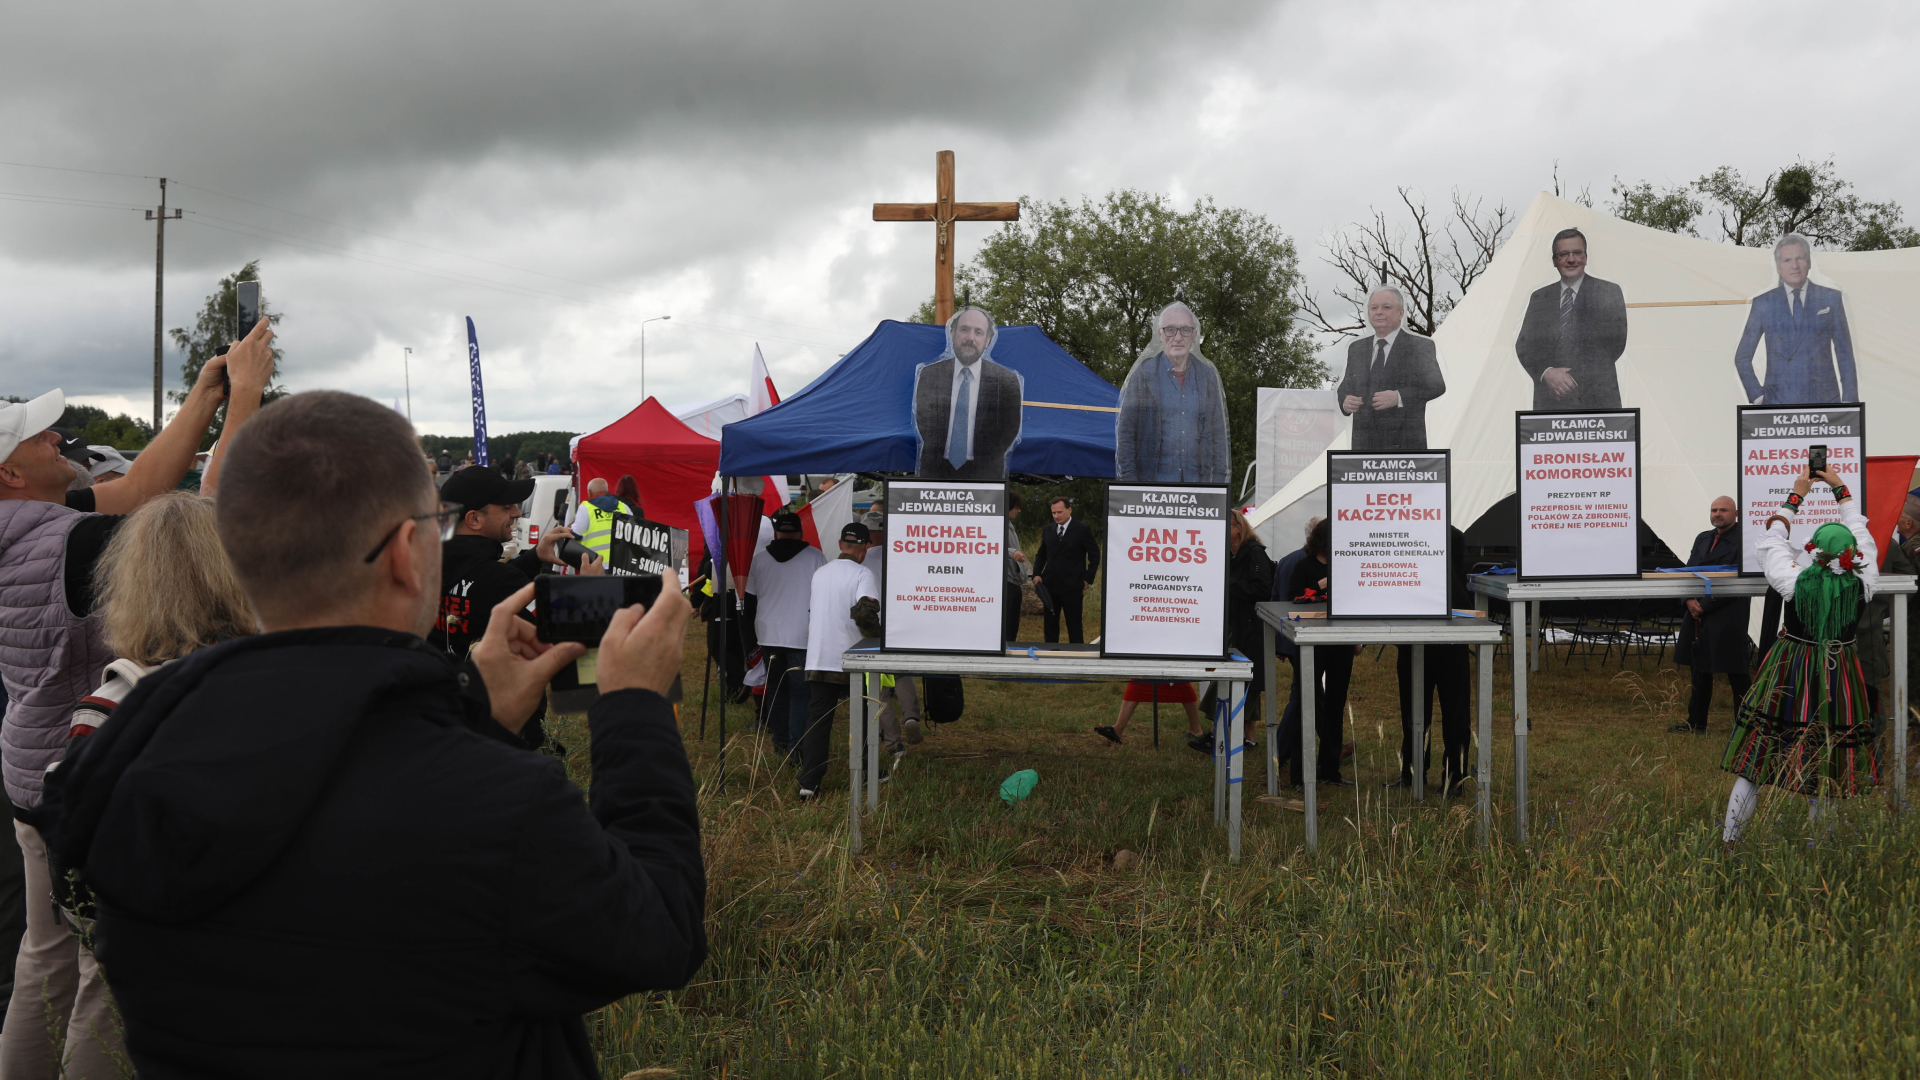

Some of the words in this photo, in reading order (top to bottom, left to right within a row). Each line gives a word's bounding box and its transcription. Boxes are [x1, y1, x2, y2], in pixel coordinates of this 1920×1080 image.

[1552, 419, 1606, 430] KŁAMCA
[1773, 414, 1829, 425] KŁAMCA
[1530, 429, 1628, 442] JEDWABIEŃSKI
[1751, 424, 1851, 437] JEDWABIEŃSKI
[1533, 452, 1625, 465] BRONISŁAW
[1748, 447, 1855, 460] ALEKSADER
[1362, 460, 1416, 469] KŁAMCA
[1744, 462, 1859, 476] KWAŚNSKI
[1341, 470, 1438, 481] JEDWABIEŃSKI
[1525, 467, 1633, 480] KOMOROWSKI
[920, 490, 975, 501] KŁAMCA
[1142, 493, 1198, 505] KŁAMCA
[1366, 494, 1412, 506] LECH
[898, 502, 996, 514] JEDWABIEŃSKI
[1119, 505, 1219, 517] JEDWABIEŃSKI
[1338, 506, 1441, 521] KACZYŃSKI
[1528, 513, 1570, 521] POLAKÓW
[615, 519, 669, 554] DOKOŃC
[907, 525, 987, 539] MICHAEL
[1132, 528, 1178, 545] JAN
[1186, 530, 1204, 546] T.
[893, 541, 999, 555] SCHUDRICH
[1349, 540, 1430, 548] SPRAWIEDLIWOŚCI,
[1128, 546, 1207, 564] GROSS
[928, 566, 964, 575] RABIN
[1361, 572, 1418, 580] EKSHUMACJĘ
[915, 586, 976, 594] WYLOBBOWAŁ
[1130, 583, 1203, 592] PROPAGANDYSTA
[897, 595, 936, 603] BLOKADĘ
[1133, 596, 1199, 605] SFORMUŁOWAŁ
[1141, 606, 1190, 614] KŁAMSTWO
[1130, 615, 1200, 624] JEDWABIEŃSKIE
